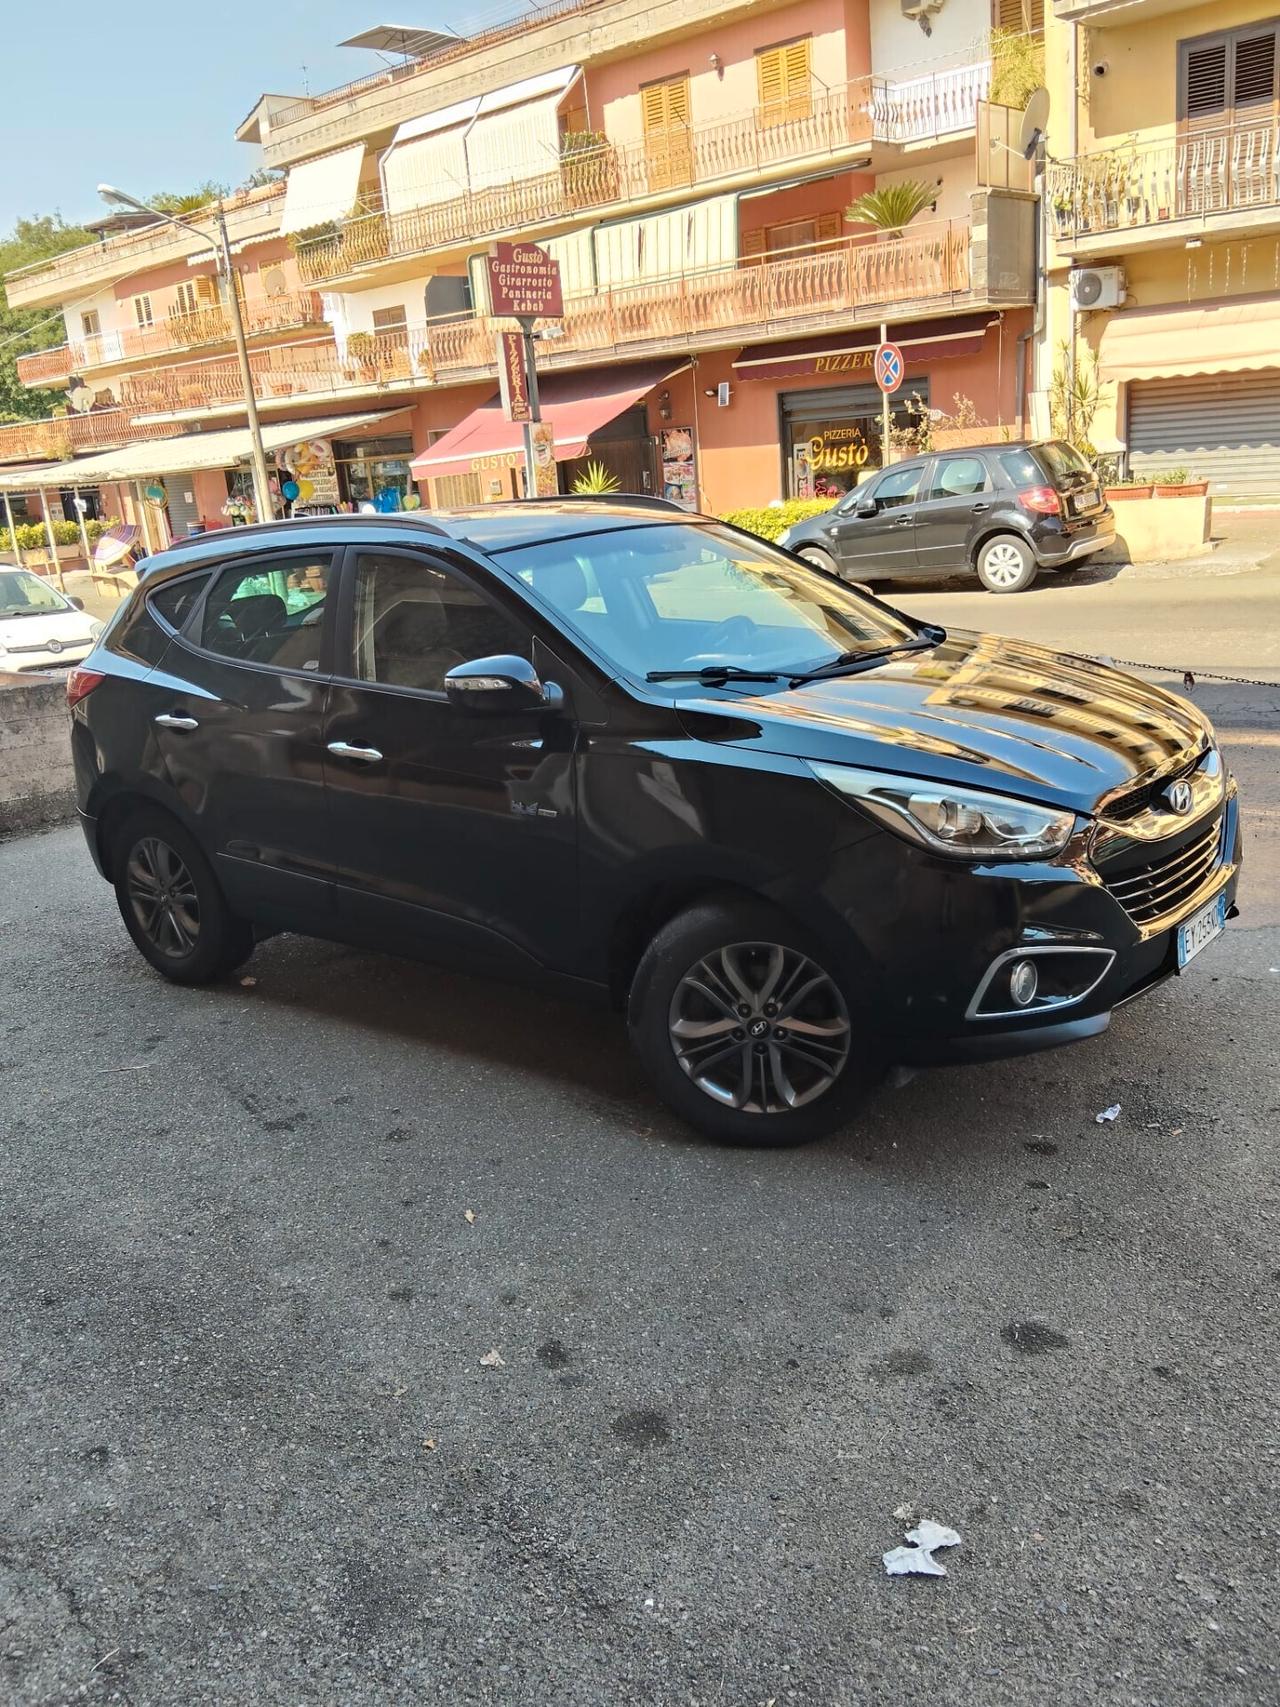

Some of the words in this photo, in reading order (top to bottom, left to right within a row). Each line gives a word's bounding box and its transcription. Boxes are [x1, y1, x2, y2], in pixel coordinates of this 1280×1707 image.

[513, 248, 543, 264] Gustò
[492, 261, 557, 275] Gastronomia
[498, 274, 553, 287] Girarrosto
[501, 286, 552, 300] Panineria
[513, 300, 544, 312] Kebab
[507, 334, 525, 402] PIZZERIA
[815, 352, 873, 372] PIZZER
[824, 427, 862, 440] PIZZERIA
[805, 436, 869, 471] Gustò
